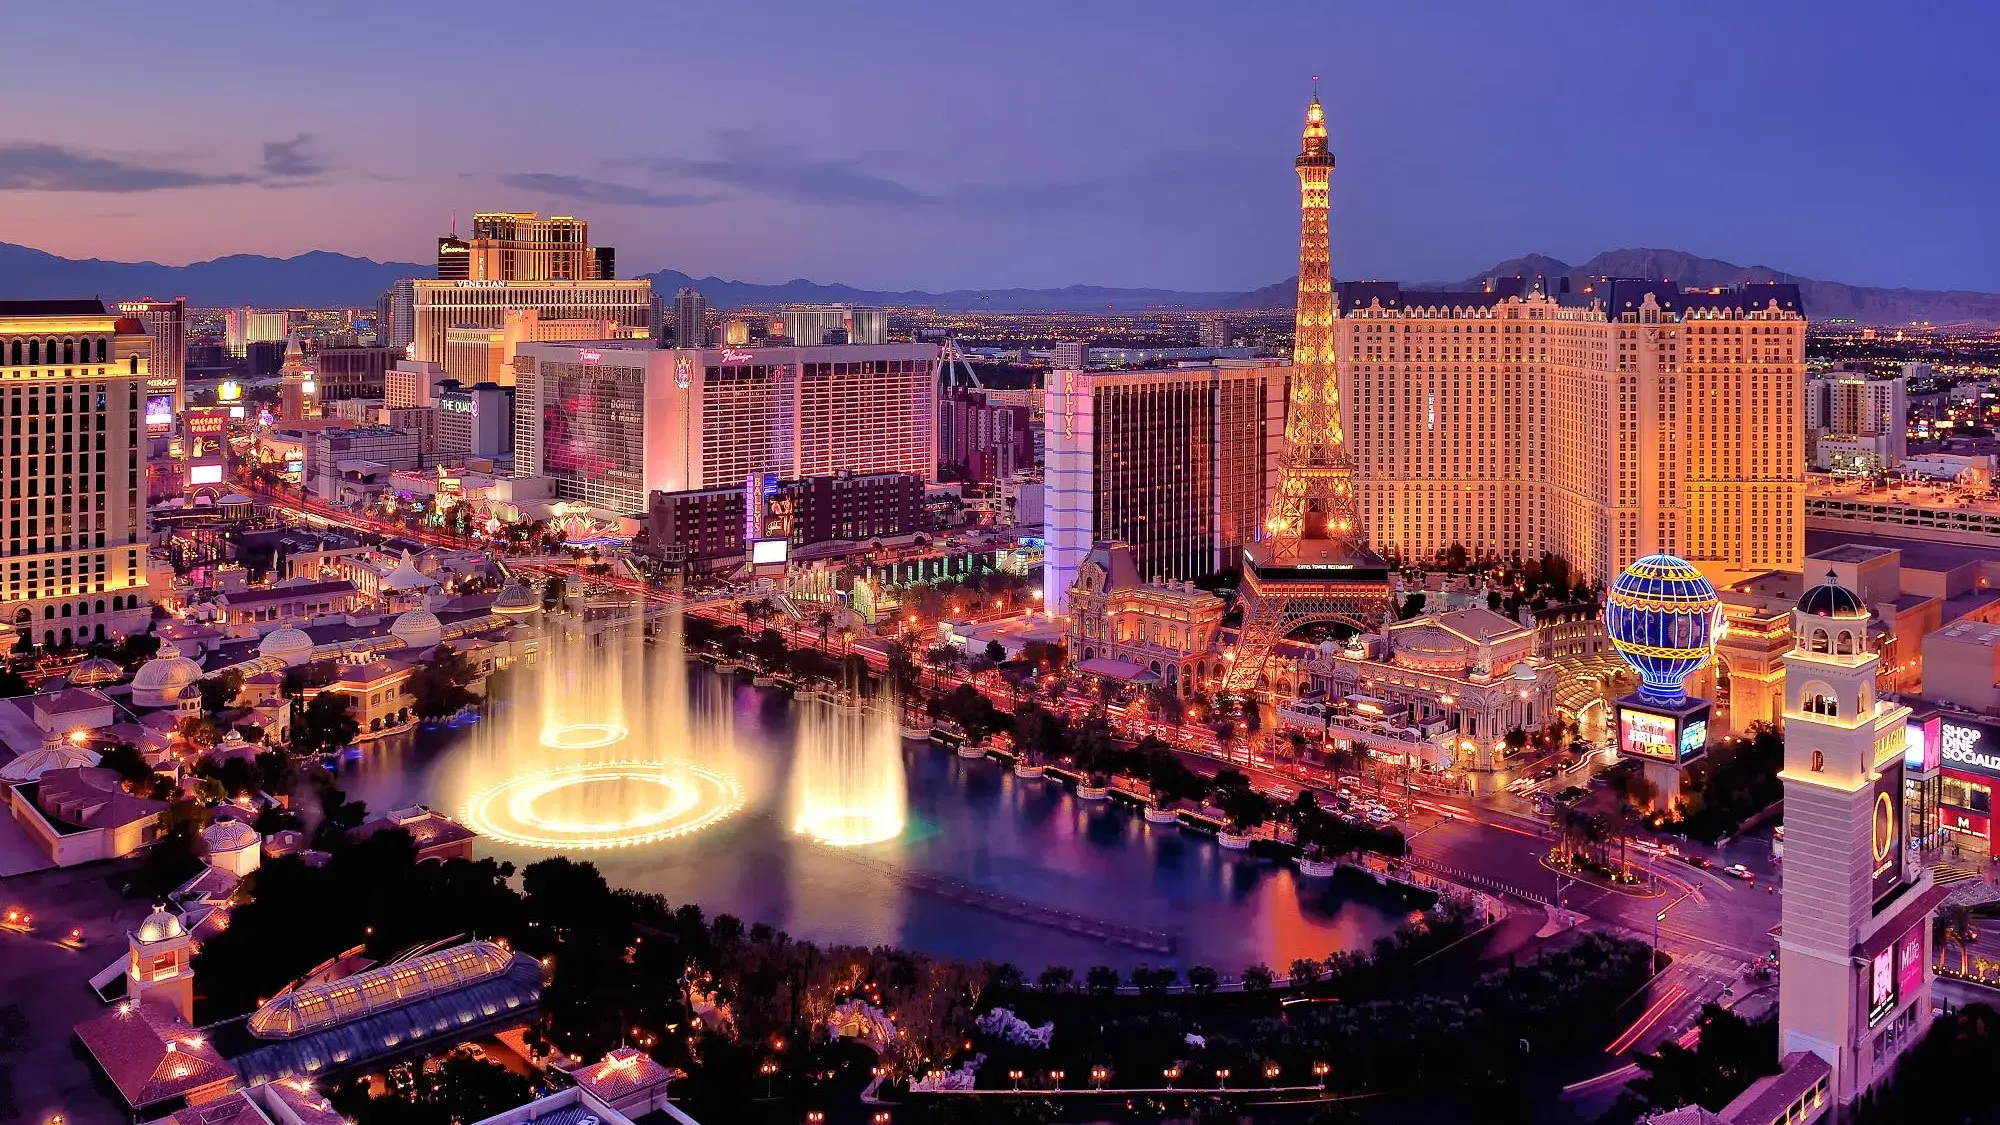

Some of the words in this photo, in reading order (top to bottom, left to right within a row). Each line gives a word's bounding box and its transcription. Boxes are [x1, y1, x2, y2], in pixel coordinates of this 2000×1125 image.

[456, 280, 505, 288] VENETIAN
[721, 349, 753, 364] Flamingo
[442, 400, 455, 411] THE
[455, 401, 472, 414] QUAD
[189, 417, 225, 426] CAESARS
[191, 425, 222, 433] PALACE
[1942, 724, 1981, 743] SHOP
[1942, 739, 1975, 754] DINE
[1872, 791, 1894, 863] O
[1957, 816, 1970, 829] M
